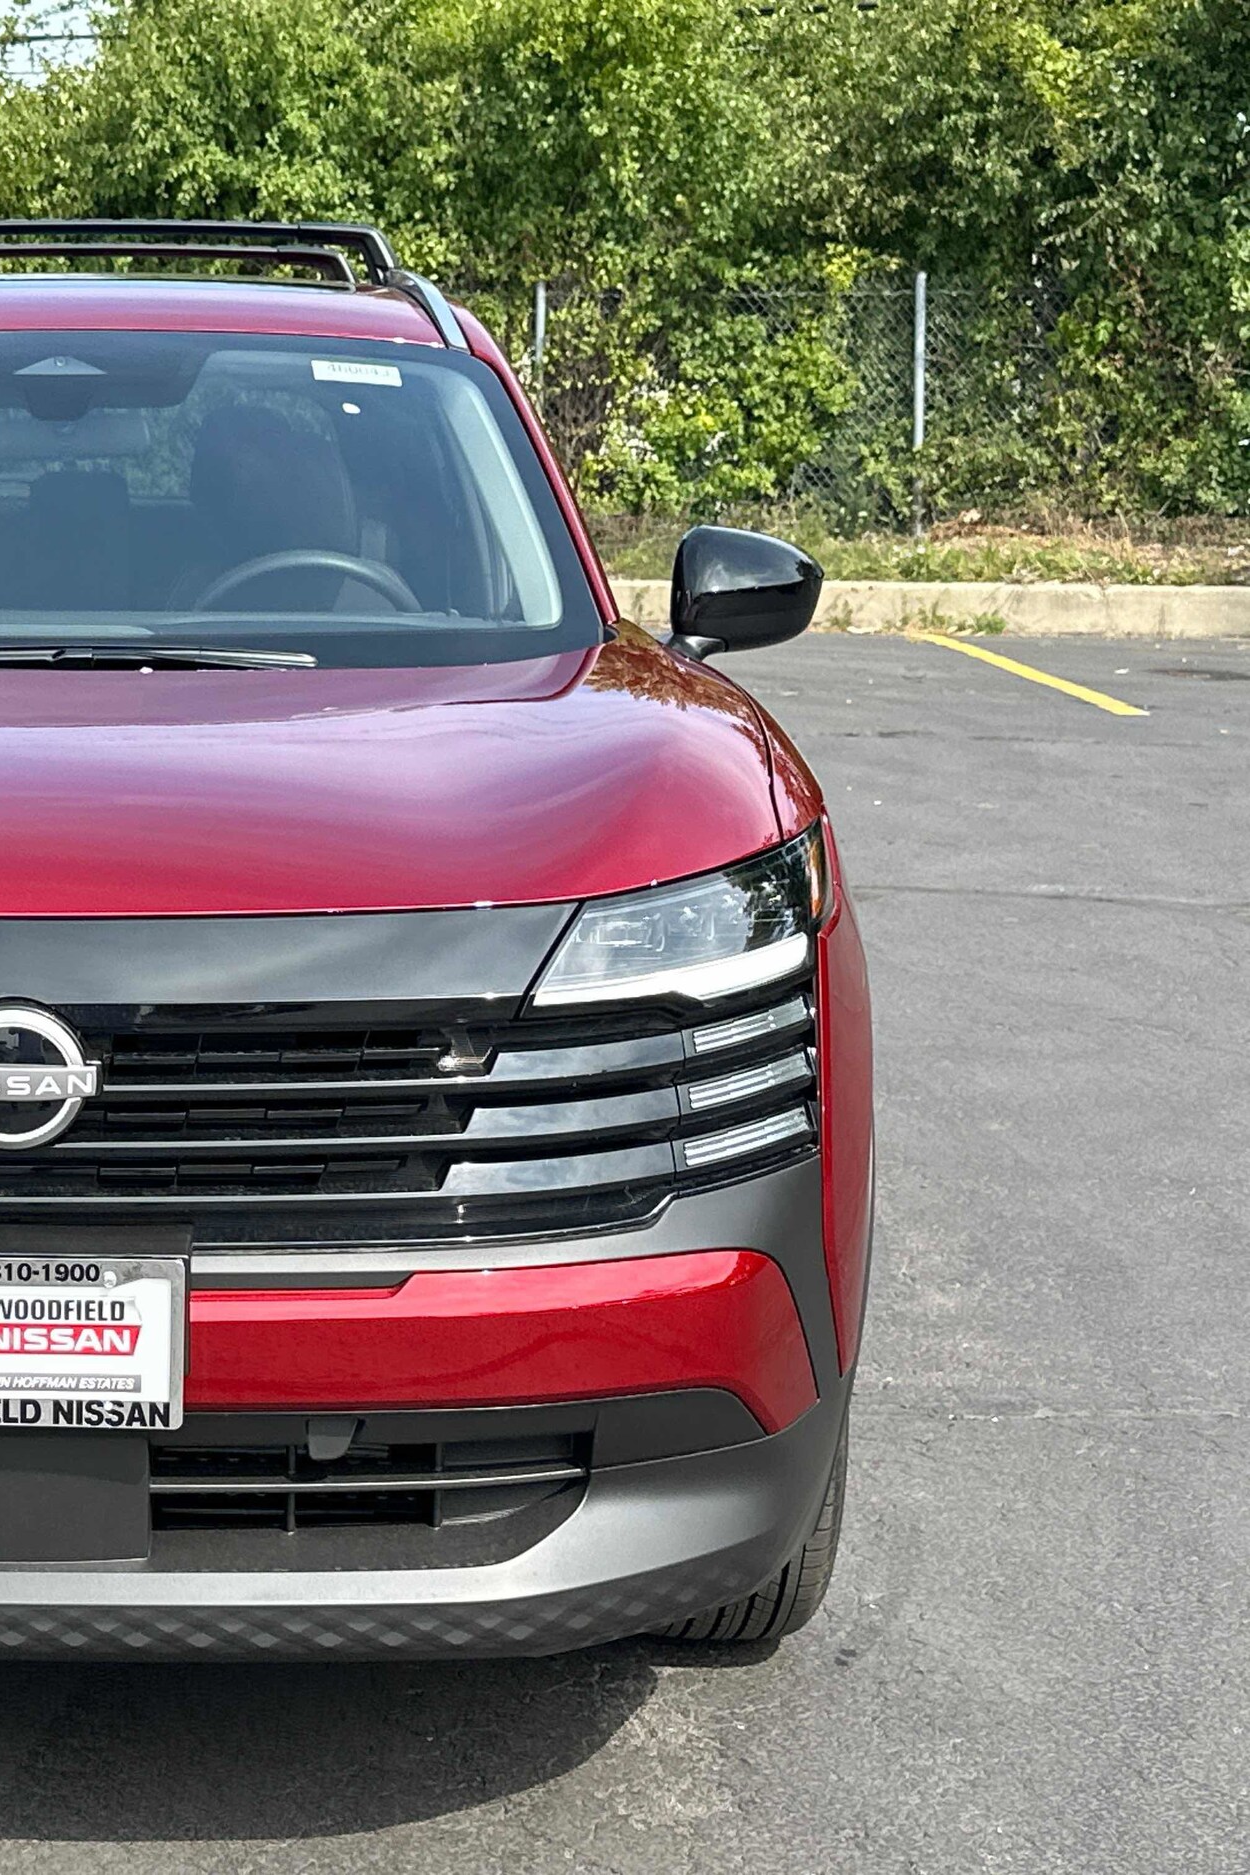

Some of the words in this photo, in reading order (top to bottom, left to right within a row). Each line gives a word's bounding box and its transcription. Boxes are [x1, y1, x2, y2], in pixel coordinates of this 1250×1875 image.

[12, 1376, 77, 1389] HOFFMAN
[78, 1377, 134, 1390] ESTATES
[52, 1400, 171, 1428] NISSAN
